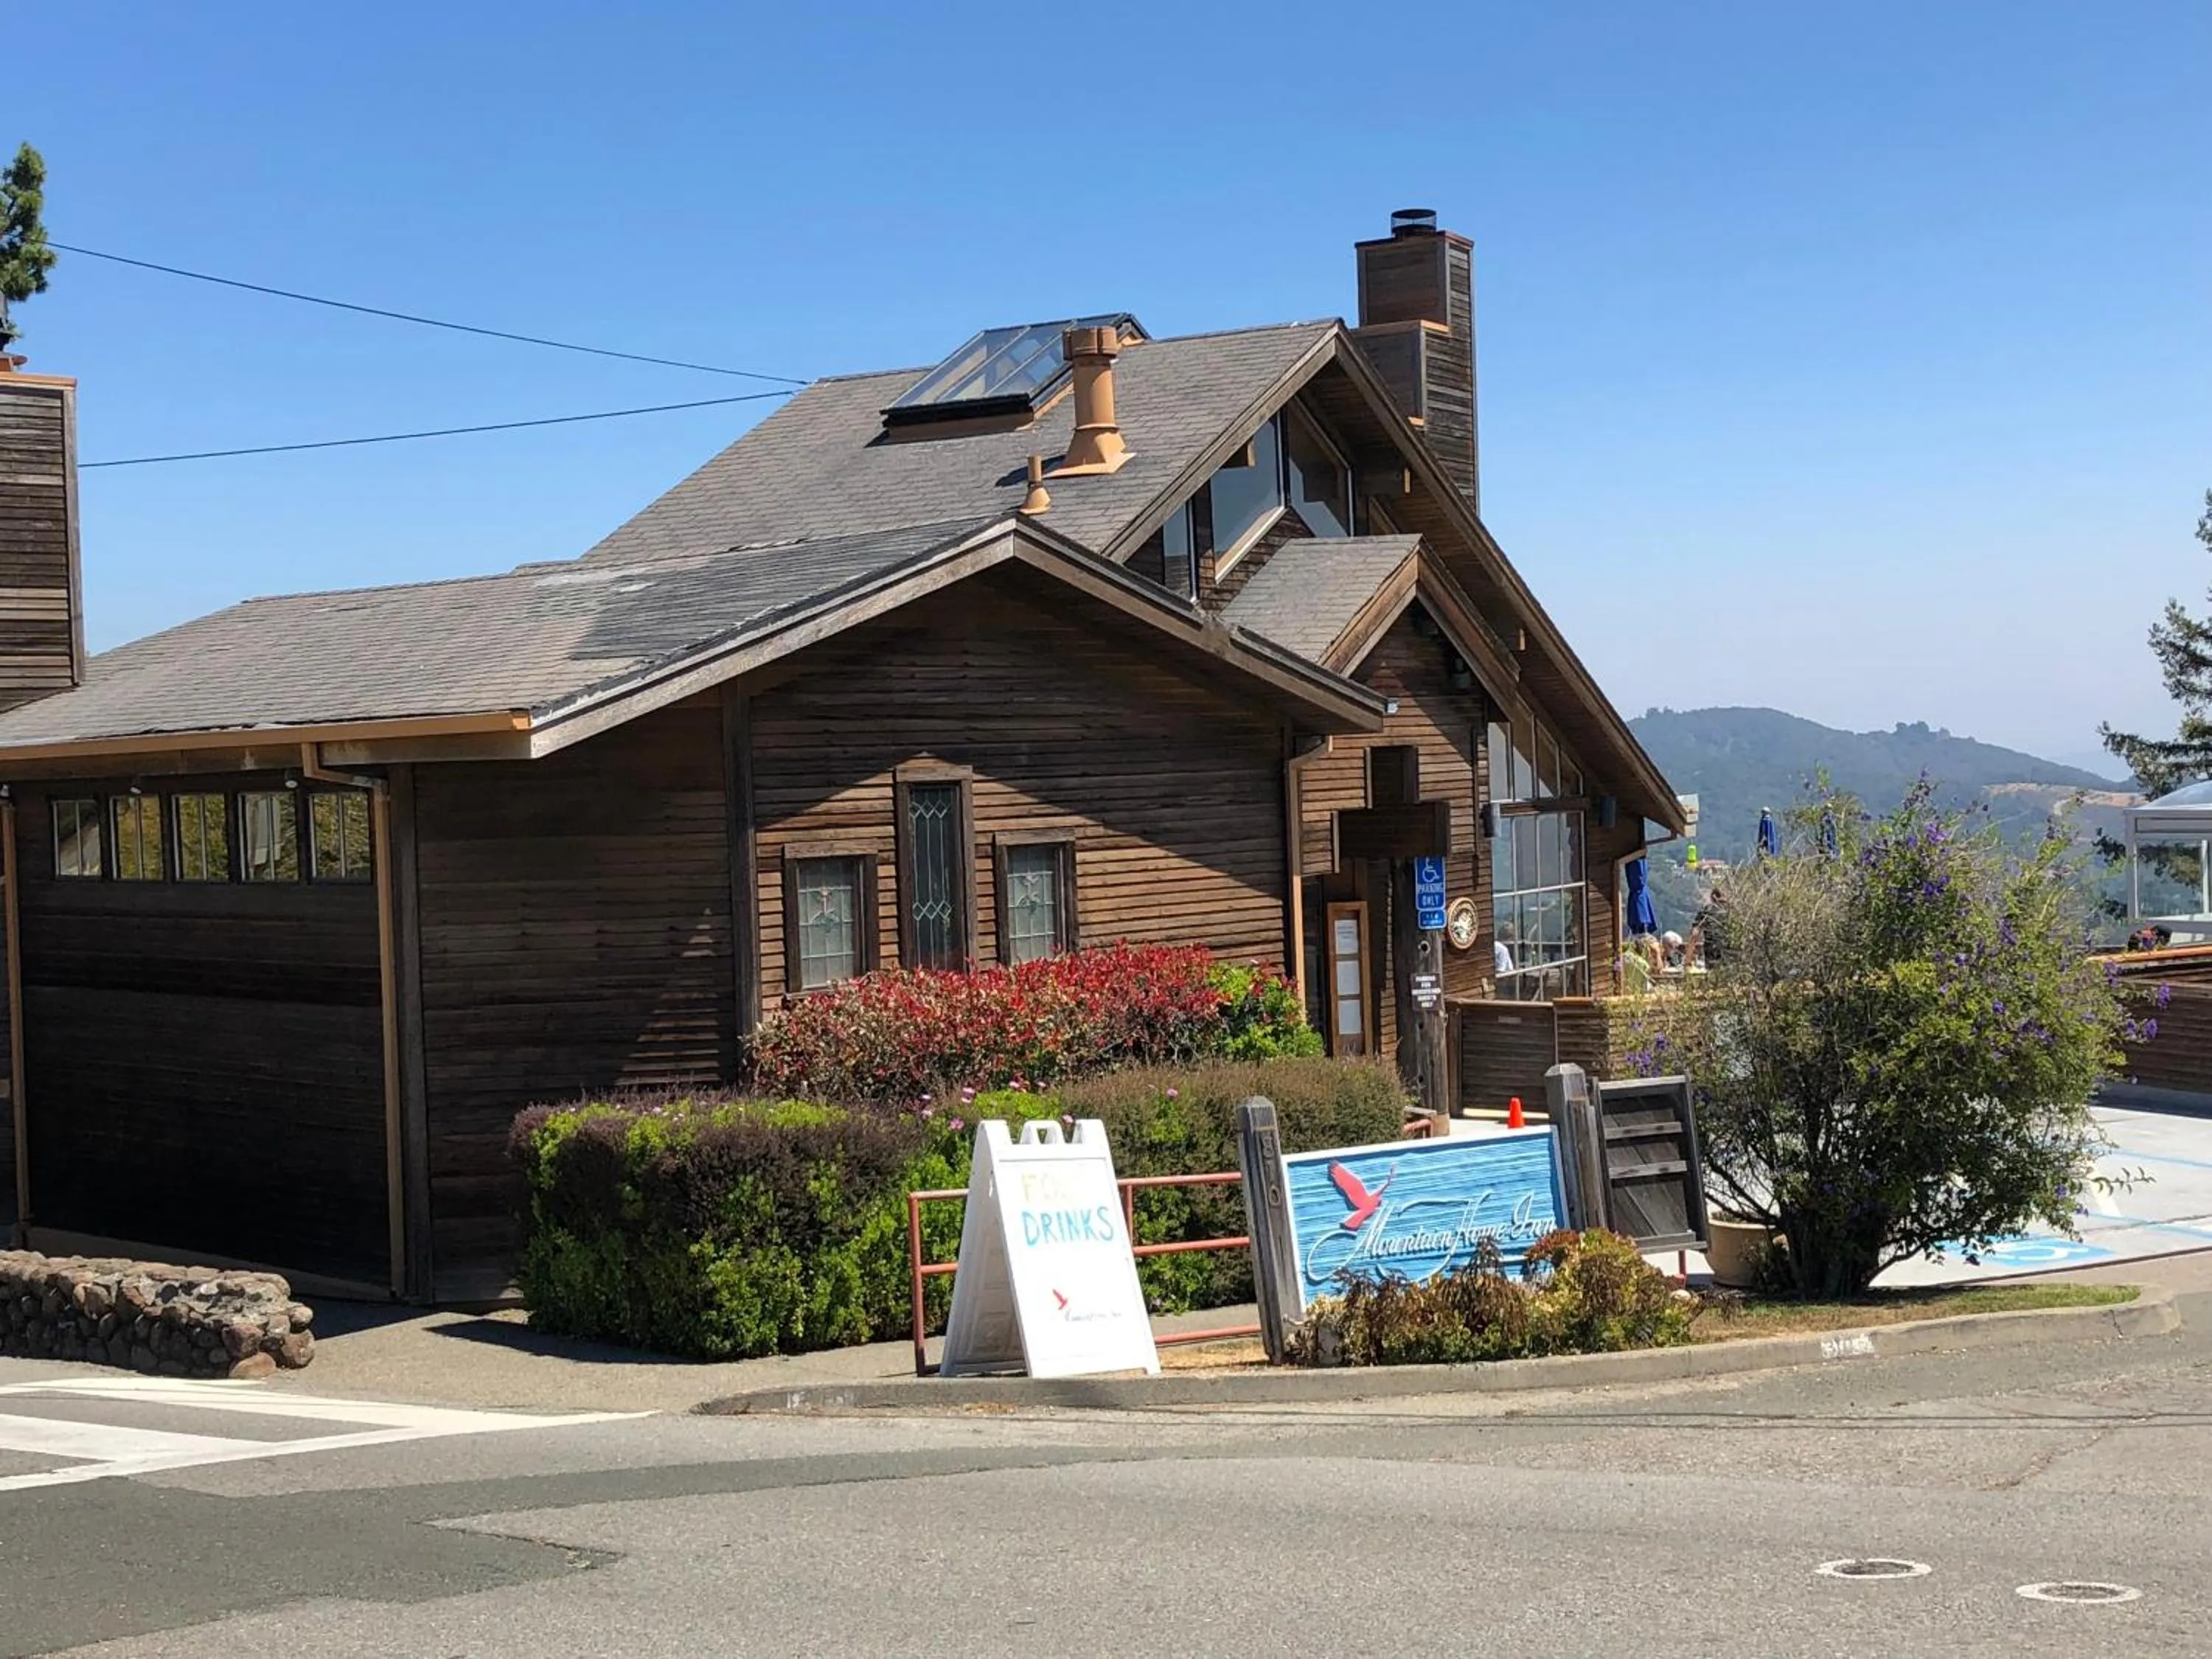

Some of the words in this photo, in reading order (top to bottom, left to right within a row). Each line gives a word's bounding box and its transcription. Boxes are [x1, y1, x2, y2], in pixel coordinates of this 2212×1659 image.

[1020, 1205, 1115, 1247] DRINKS
[1308, 1200, 1454, 1272] Mountain
[1511, 1189, 1557, 1240] Inn
